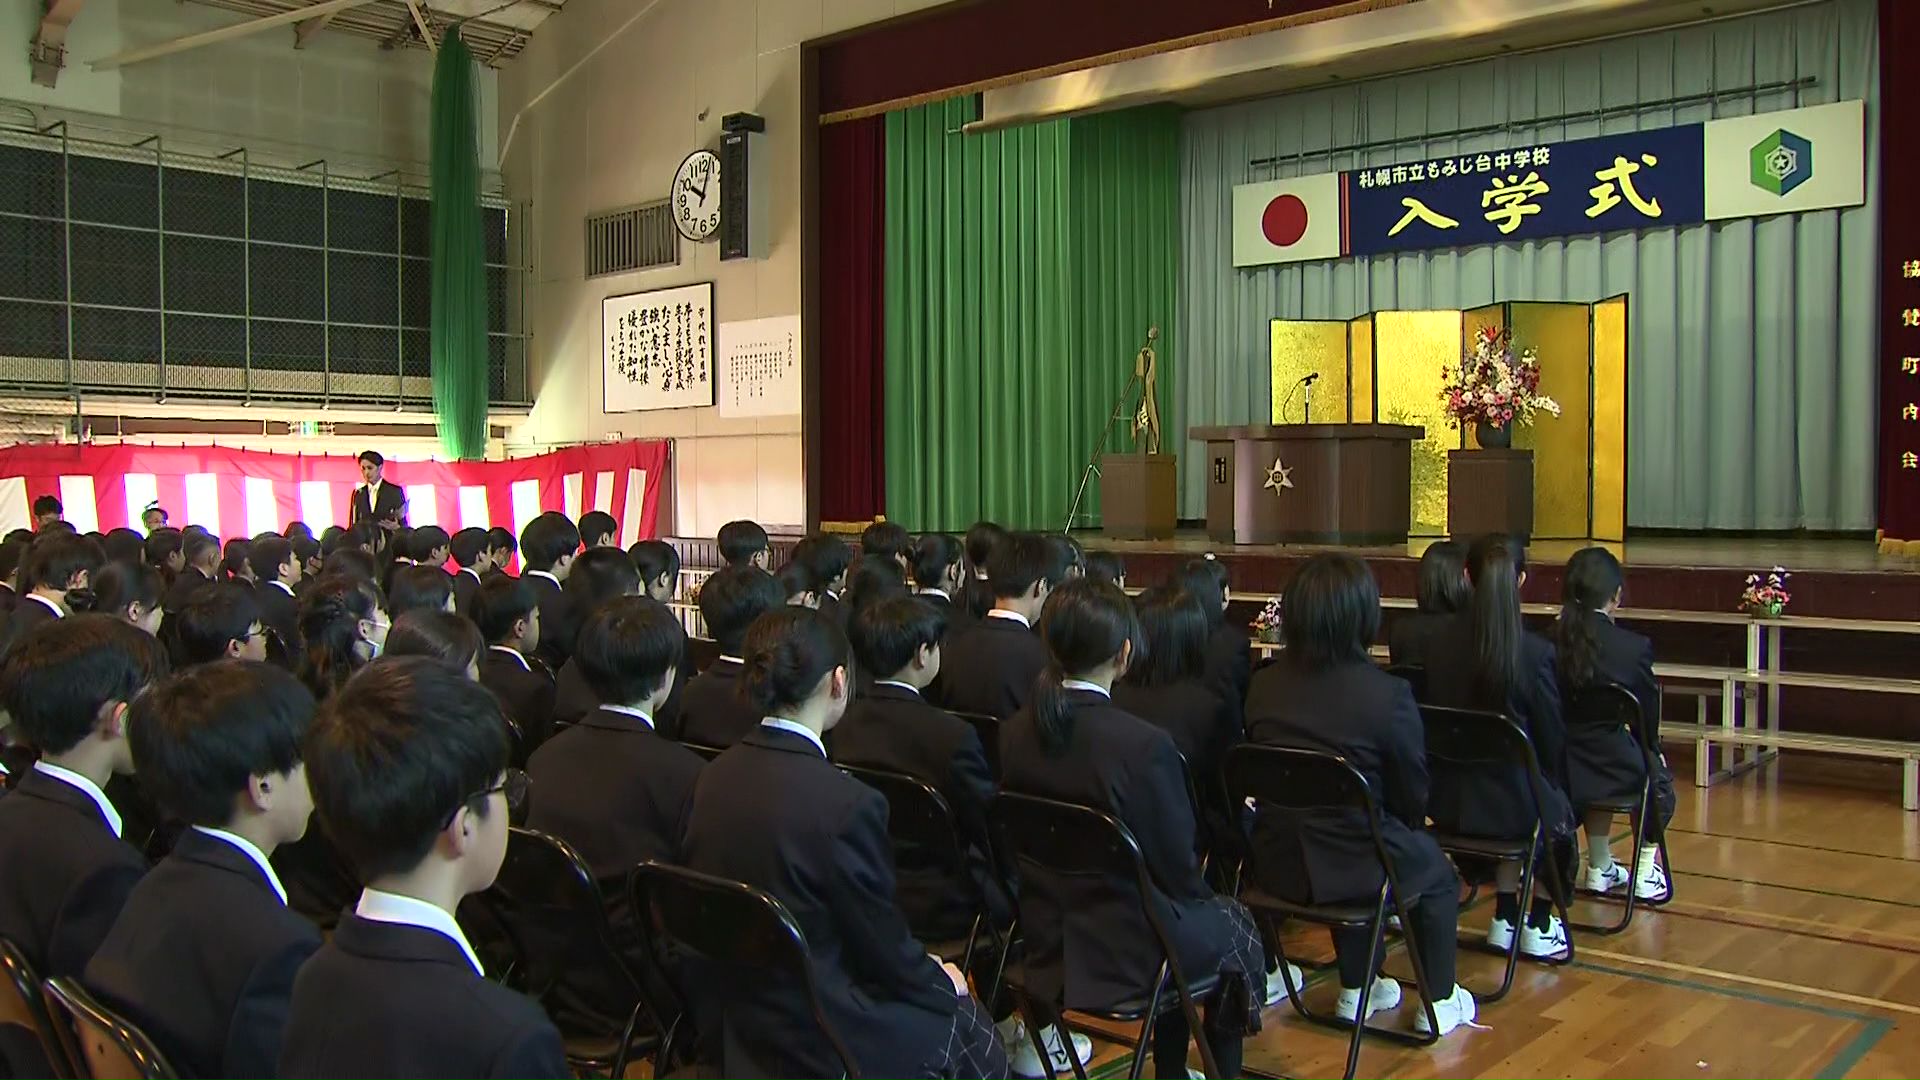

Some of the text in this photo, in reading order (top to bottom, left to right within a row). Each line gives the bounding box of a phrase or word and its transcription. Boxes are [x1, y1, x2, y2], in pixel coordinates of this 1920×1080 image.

[689, 163, 698, 178] 11
[699, 159, 708, 173] 12
[1359, 147, 1550, 188] 札幌市立もみじ台中学校
[682, 177, 692, 192] 10
[680, 194, 687, 208] 9
[1387, 153, 1662, 236] 入学式
[683, 208, 690, 221] 8
[710, 213, 717, 227] 5
[691, 218, 698, 231] 7
[700, 219, 707, 233] 6
